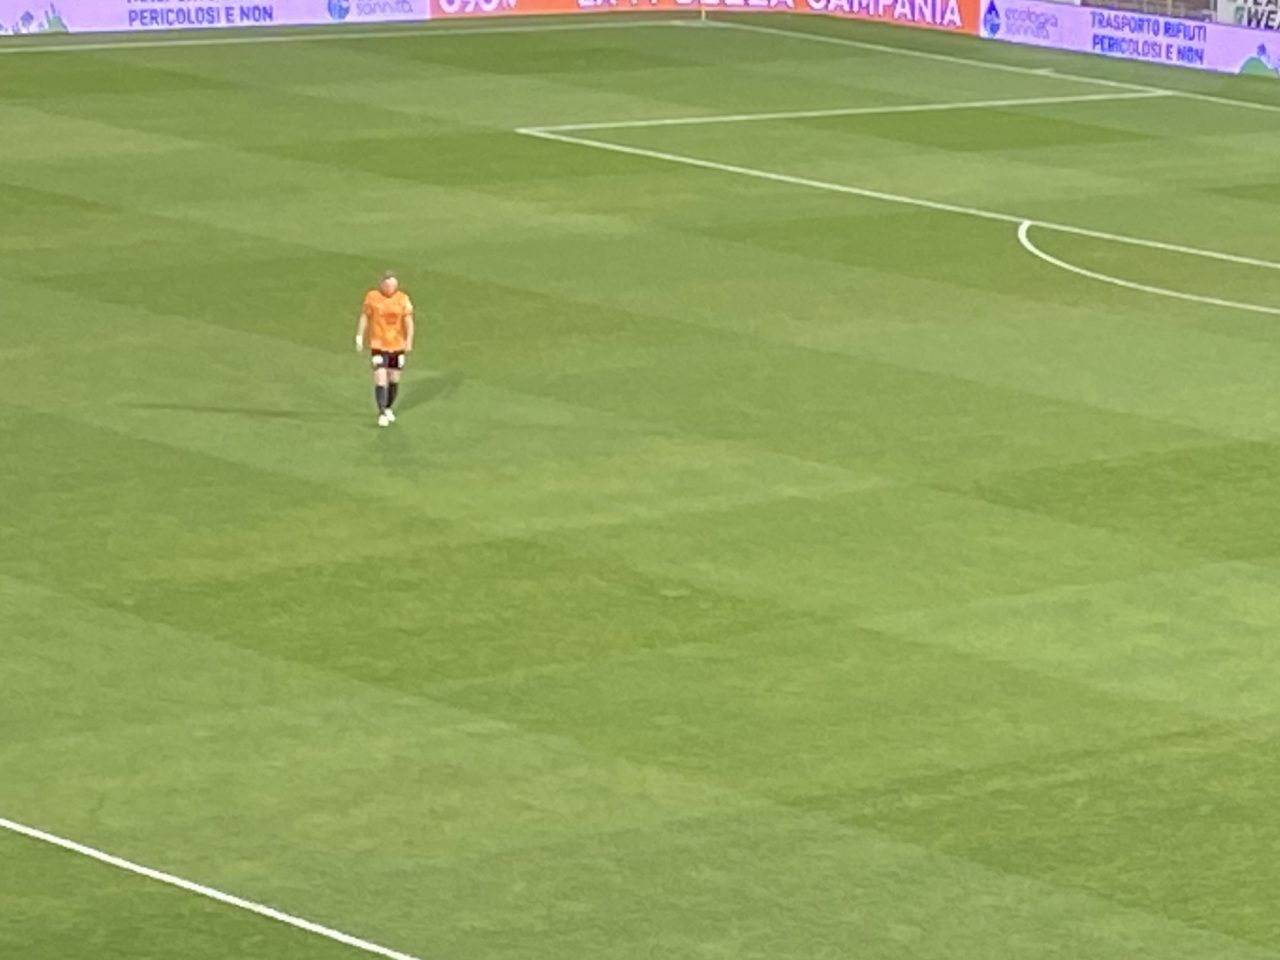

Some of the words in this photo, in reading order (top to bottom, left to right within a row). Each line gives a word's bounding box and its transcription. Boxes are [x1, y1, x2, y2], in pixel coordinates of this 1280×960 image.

[128, 7, 220, 26] PERICOLOSI
[224, 8, 234, 24] E
[239, 5, 273, 23] NON
[1091, 11, 1160, 36] TRASPORTO
[1163, 20, 1207, 43] RIFIUTI
[1092, 34, 1163, 59] PERICOLOSI
[1166, 43, 1174, 59] E
